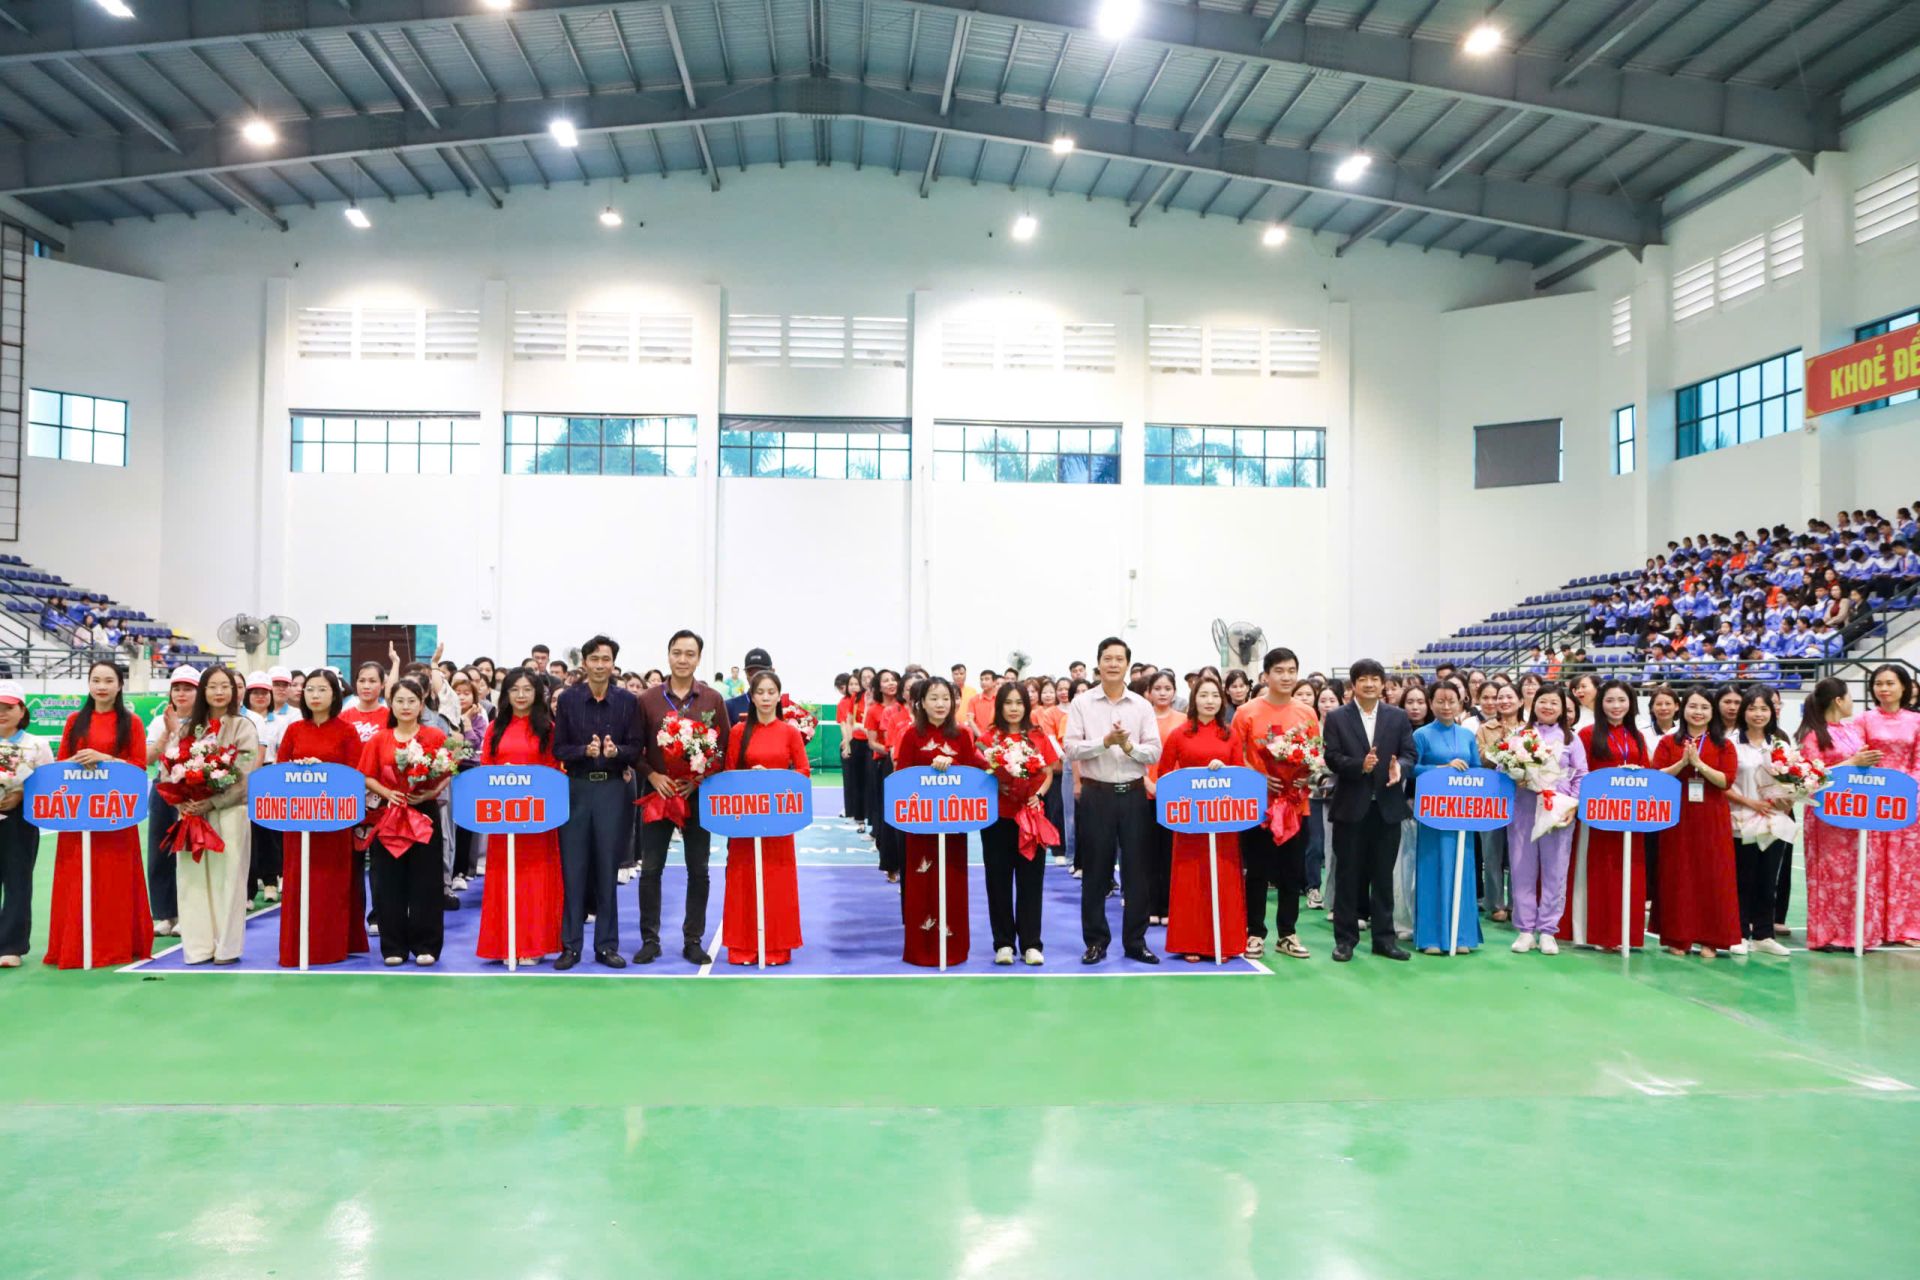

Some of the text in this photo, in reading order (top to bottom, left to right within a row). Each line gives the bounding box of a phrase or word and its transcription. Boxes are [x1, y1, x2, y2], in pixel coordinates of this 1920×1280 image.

[285, 770, 328, 783] MÔN
[488, 773, 531, 786] MÔN
[920, 773, 961, 786] MÔN
[1191, 776, 1231, 789] MÔN
[1448, 775, 1484, 787] MÔN
[1610, 775, 1648, 787] MÔN
[1848, 773, 1886, 786] MÔN
[32, 784, 139, 824] ĐẨY GẬY
[255, 790, 357, 820] BÓNG CHUYỀN HƠI
[475, 795, 545, 824] BƠI
[708, 788, 803, 821] TRỌNG TÀI
[895, 792, 988, 823] CẦU LÔNG
[1166, 795, 1259, 824] CỜ TƯỚNG
[1420, 795, 1509, 819] PICKLEBALL
[1586, 793, 1671, 823] BÓNG BÀN
[1824, 787, 1908, 821] KÉO CO
